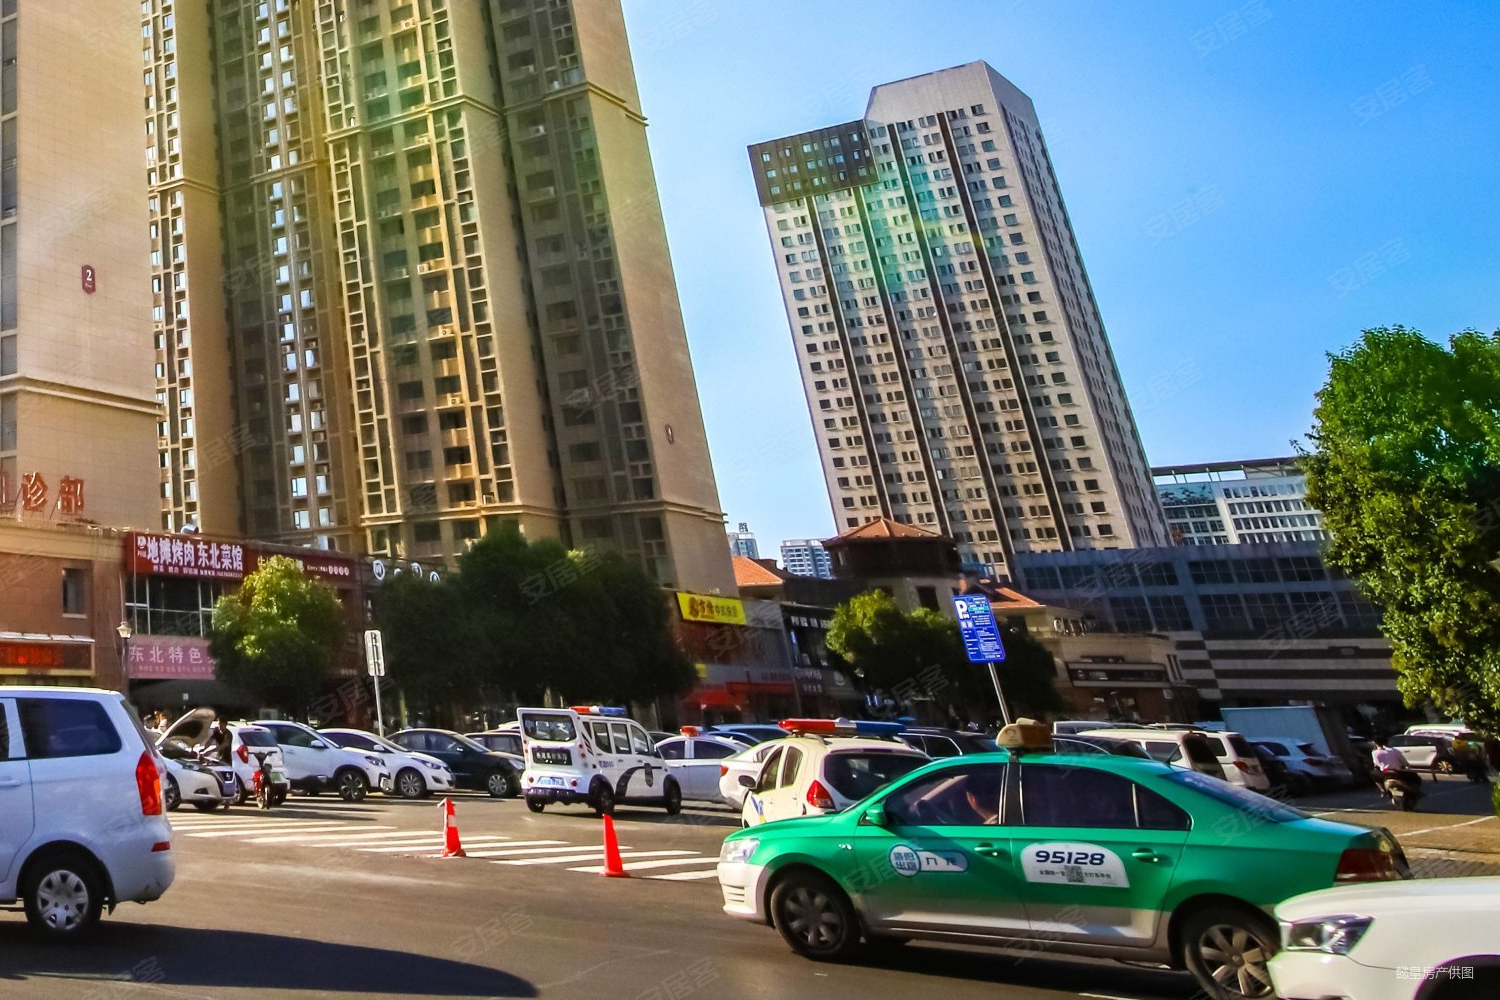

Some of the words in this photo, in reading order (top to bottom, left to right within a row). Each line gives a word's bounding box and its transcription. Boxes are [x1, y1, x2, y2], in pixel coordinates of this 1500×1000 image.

[86, 269, 92, 281] 2
[146, 536, 195, 567] 地摊烤肉
[197, 541, 243, 571] 东北菜馆
[1035, 850, 1105, 866] 95128
